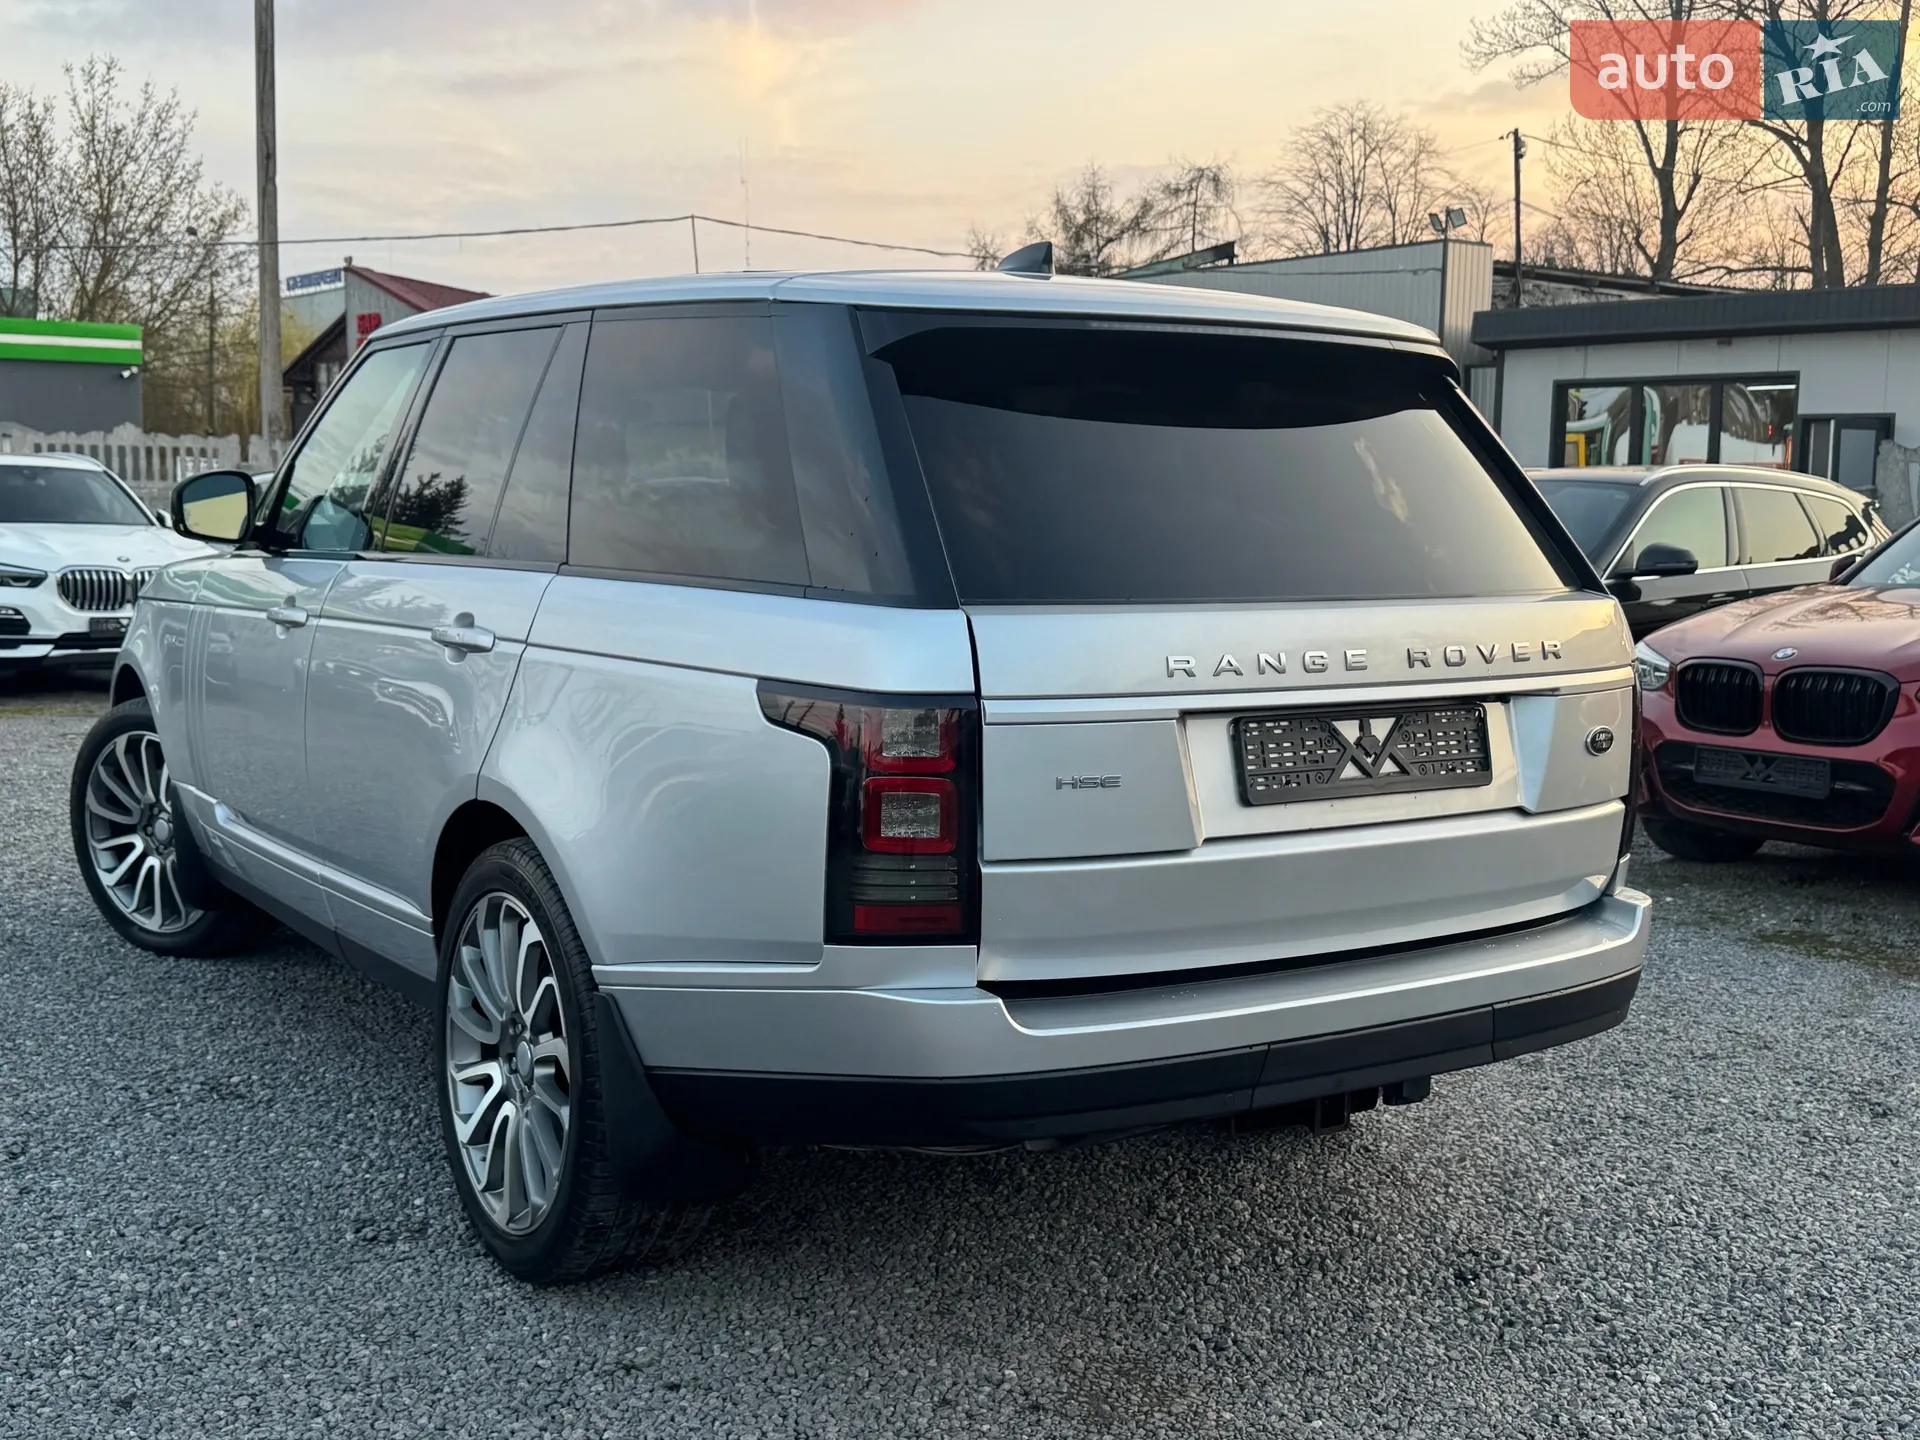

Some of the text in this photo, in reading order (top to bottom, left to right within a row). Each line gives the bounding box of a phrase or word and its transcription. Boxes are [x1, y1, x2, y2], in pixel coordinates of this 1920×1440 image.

[1166, 640, 1562, 677] RANGE ROVER
[1055, 774, 1122, 790] HSE
